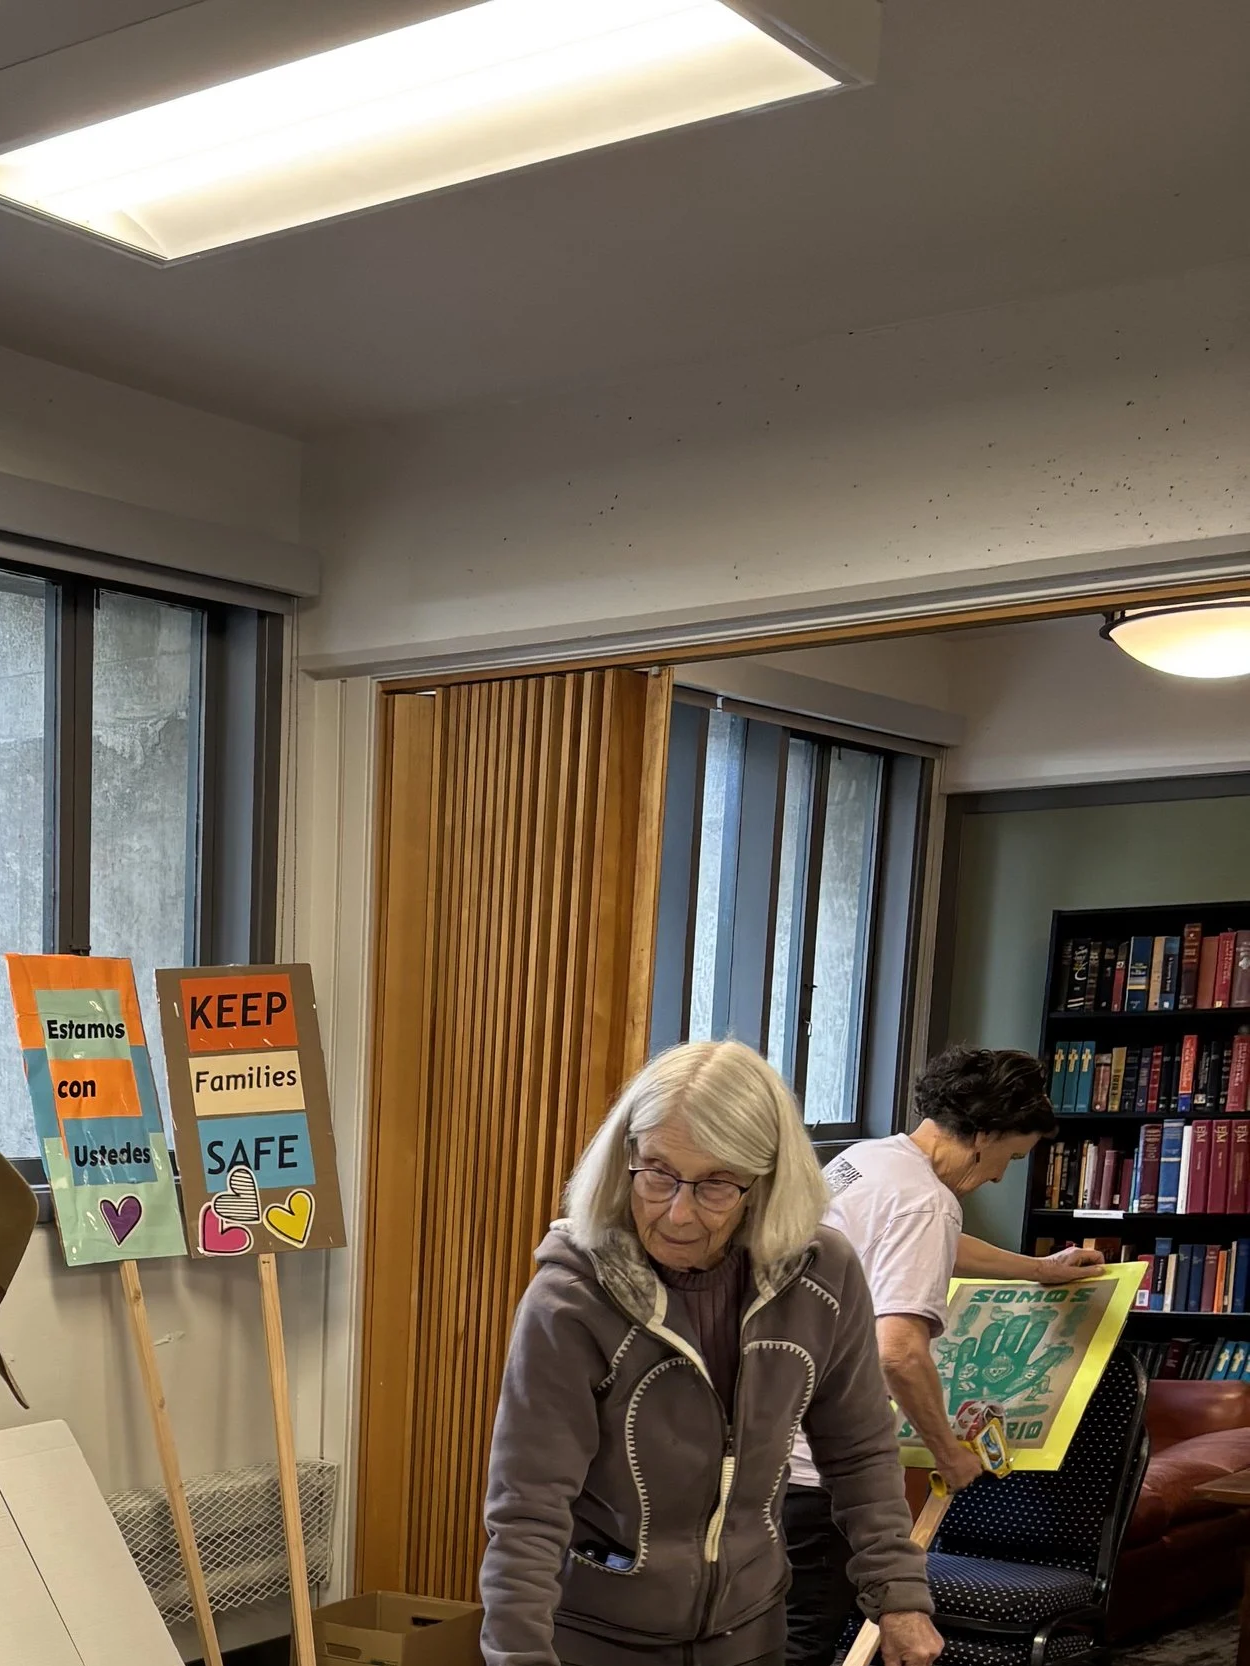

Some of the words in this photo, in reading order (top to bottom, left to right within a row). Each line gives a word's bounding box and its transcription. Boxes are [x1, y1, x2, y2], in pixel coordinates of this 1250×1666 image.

[190, 991, 287, 1031] KEEP
[46, 1019, 126, 1040] Estamos
[57, 1076, 97, 1098] con
[194, 1065, 298, 1094] Families
[73, 1141, 151, 1168] Ustedes
[207, 1134, 299, 1175] SAFE
[969, 1287, 1097, 1303] SOMOS
